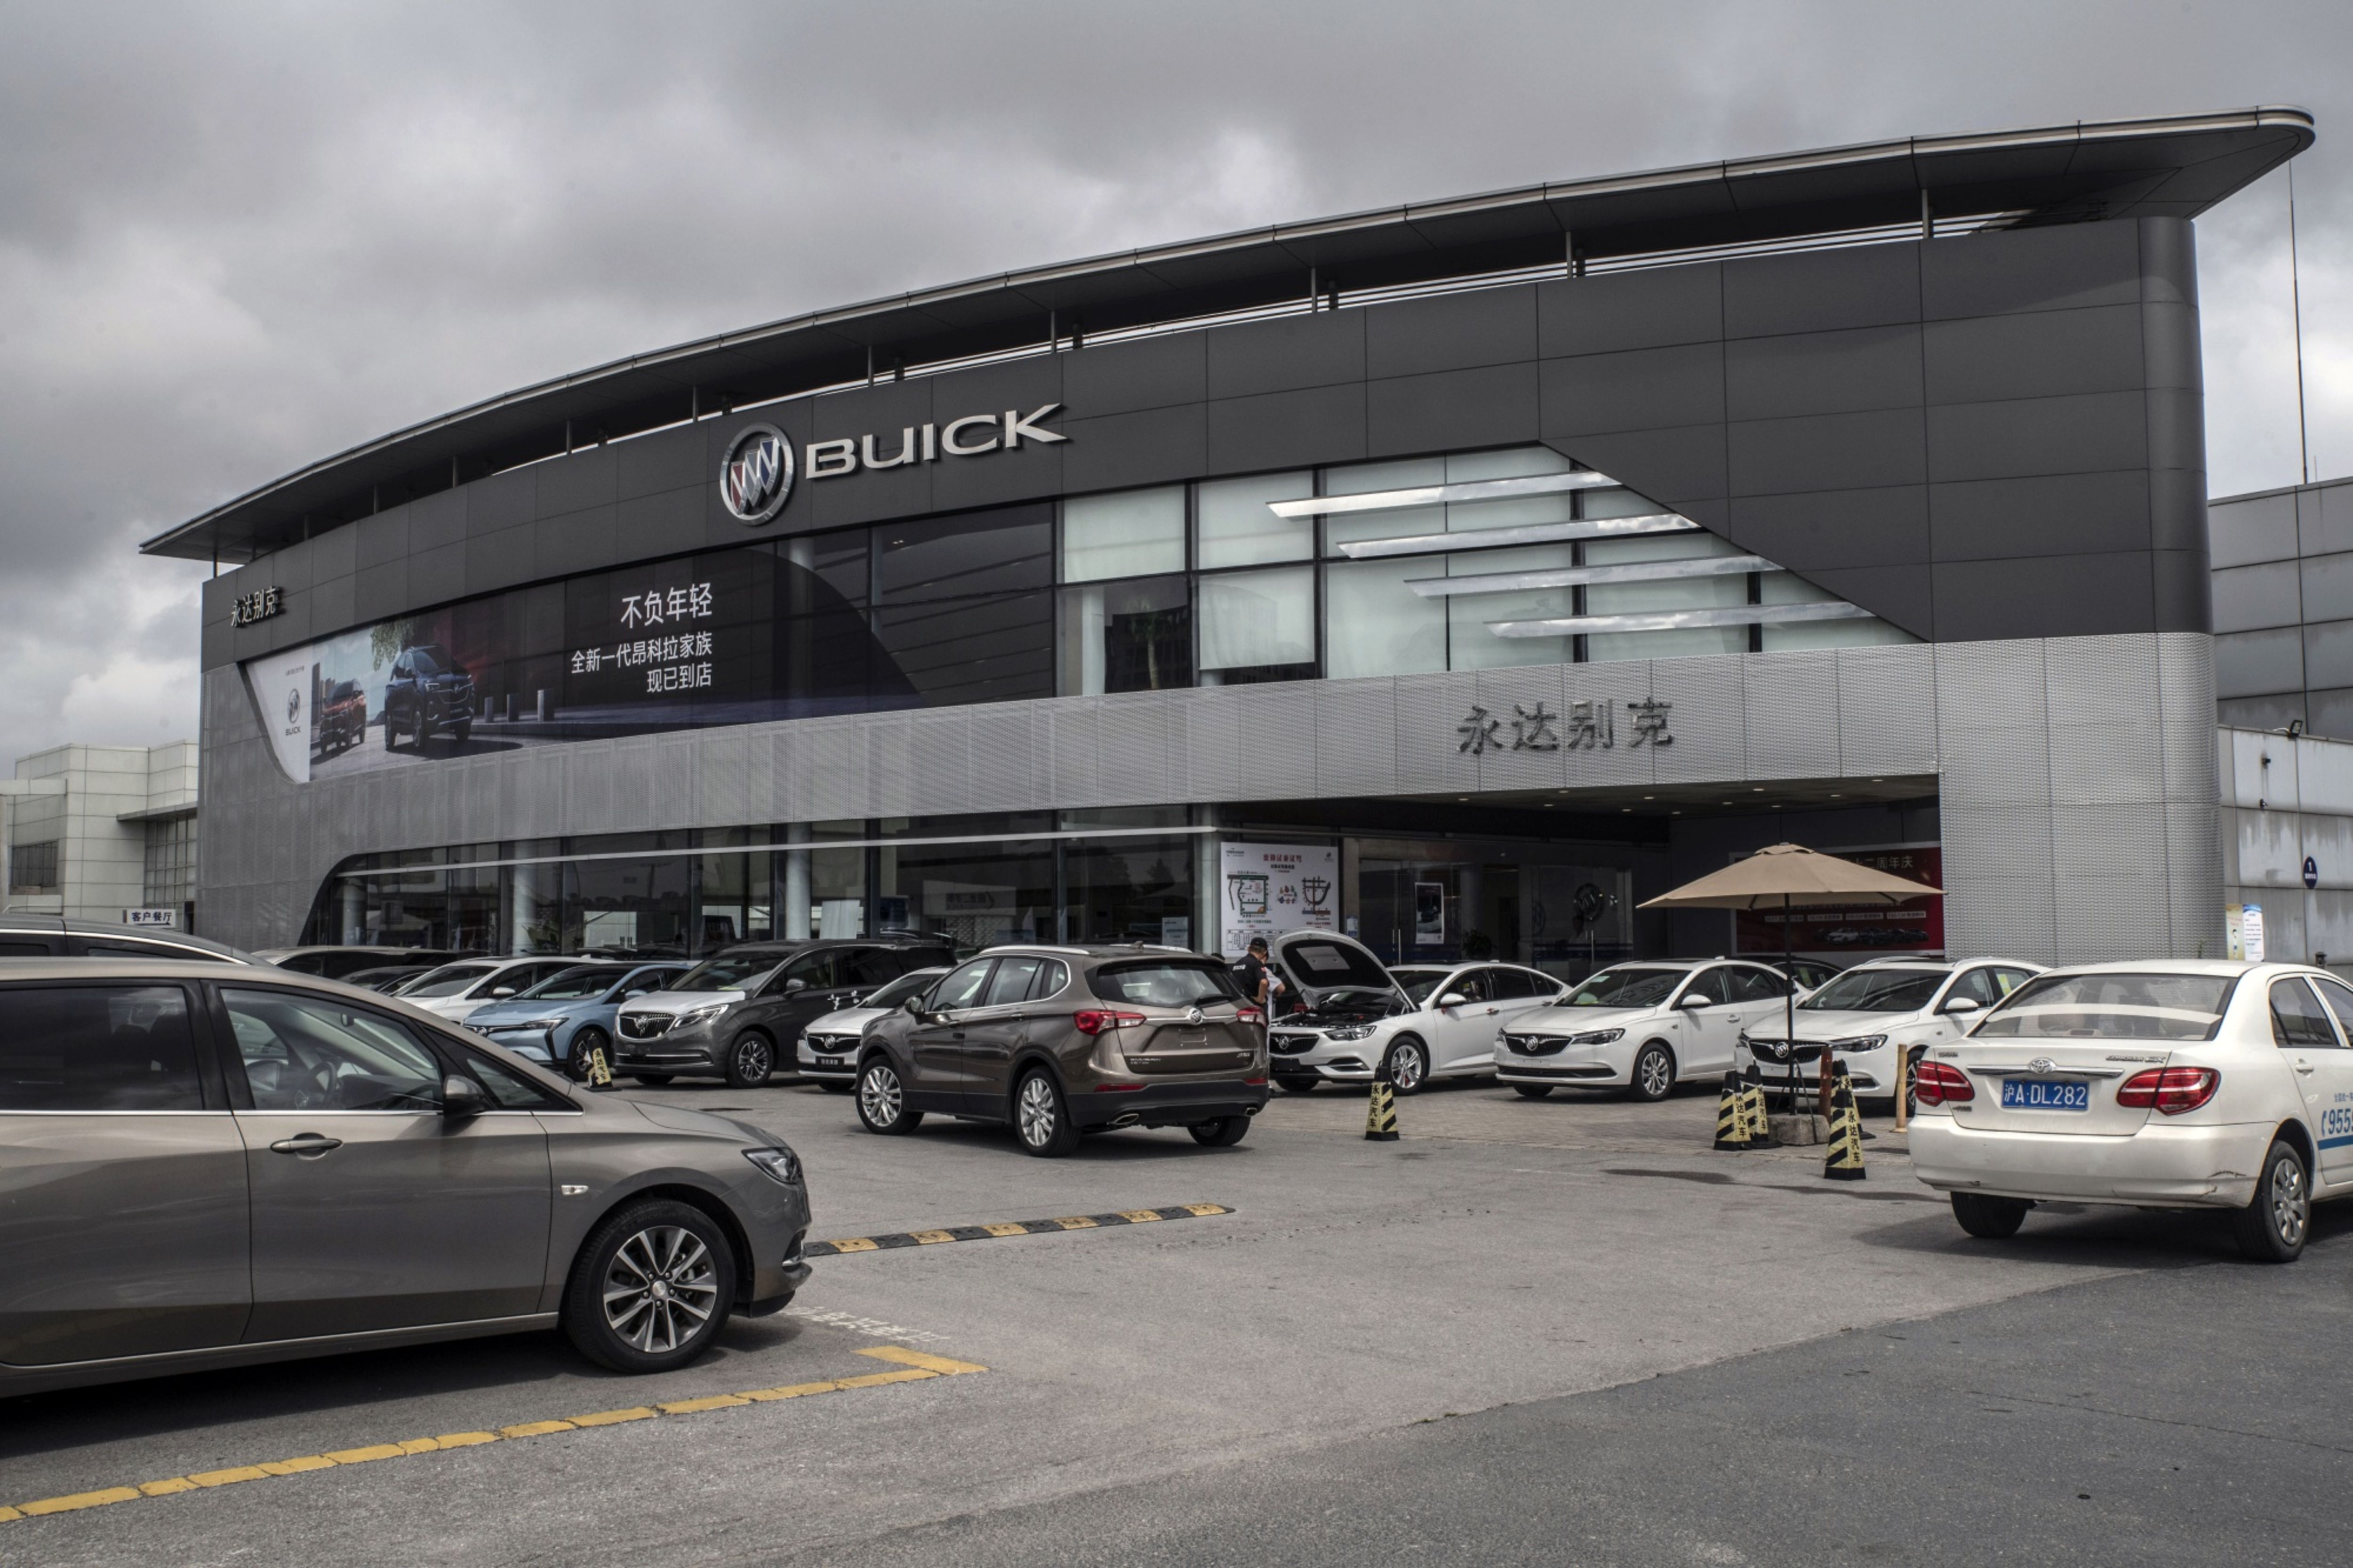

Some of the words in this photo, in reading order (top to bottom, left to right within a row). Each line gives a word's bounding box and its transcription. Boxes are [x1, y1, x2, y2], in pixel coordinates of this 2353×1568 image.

[805, 403, 1069, 480] BUICK
[231, 586, 278, 628] 永达别克
[620, 582, 713, 629] 不负年轻
[571, 631, 712, 674] 全新一代昂科拉家族
[647, 662, 712, 693] 现已到店
[285, 727, 302, 736] BUICK
[1457, 696, 1675, 755] 永达别克
[2308, 862, 2313, 872] 1
[131, 912, 172, 922] 客户餐厅
[1848, 1111, 1861, 1164] 永达汽车
[2328, 1108, 2353, 1135] 955
